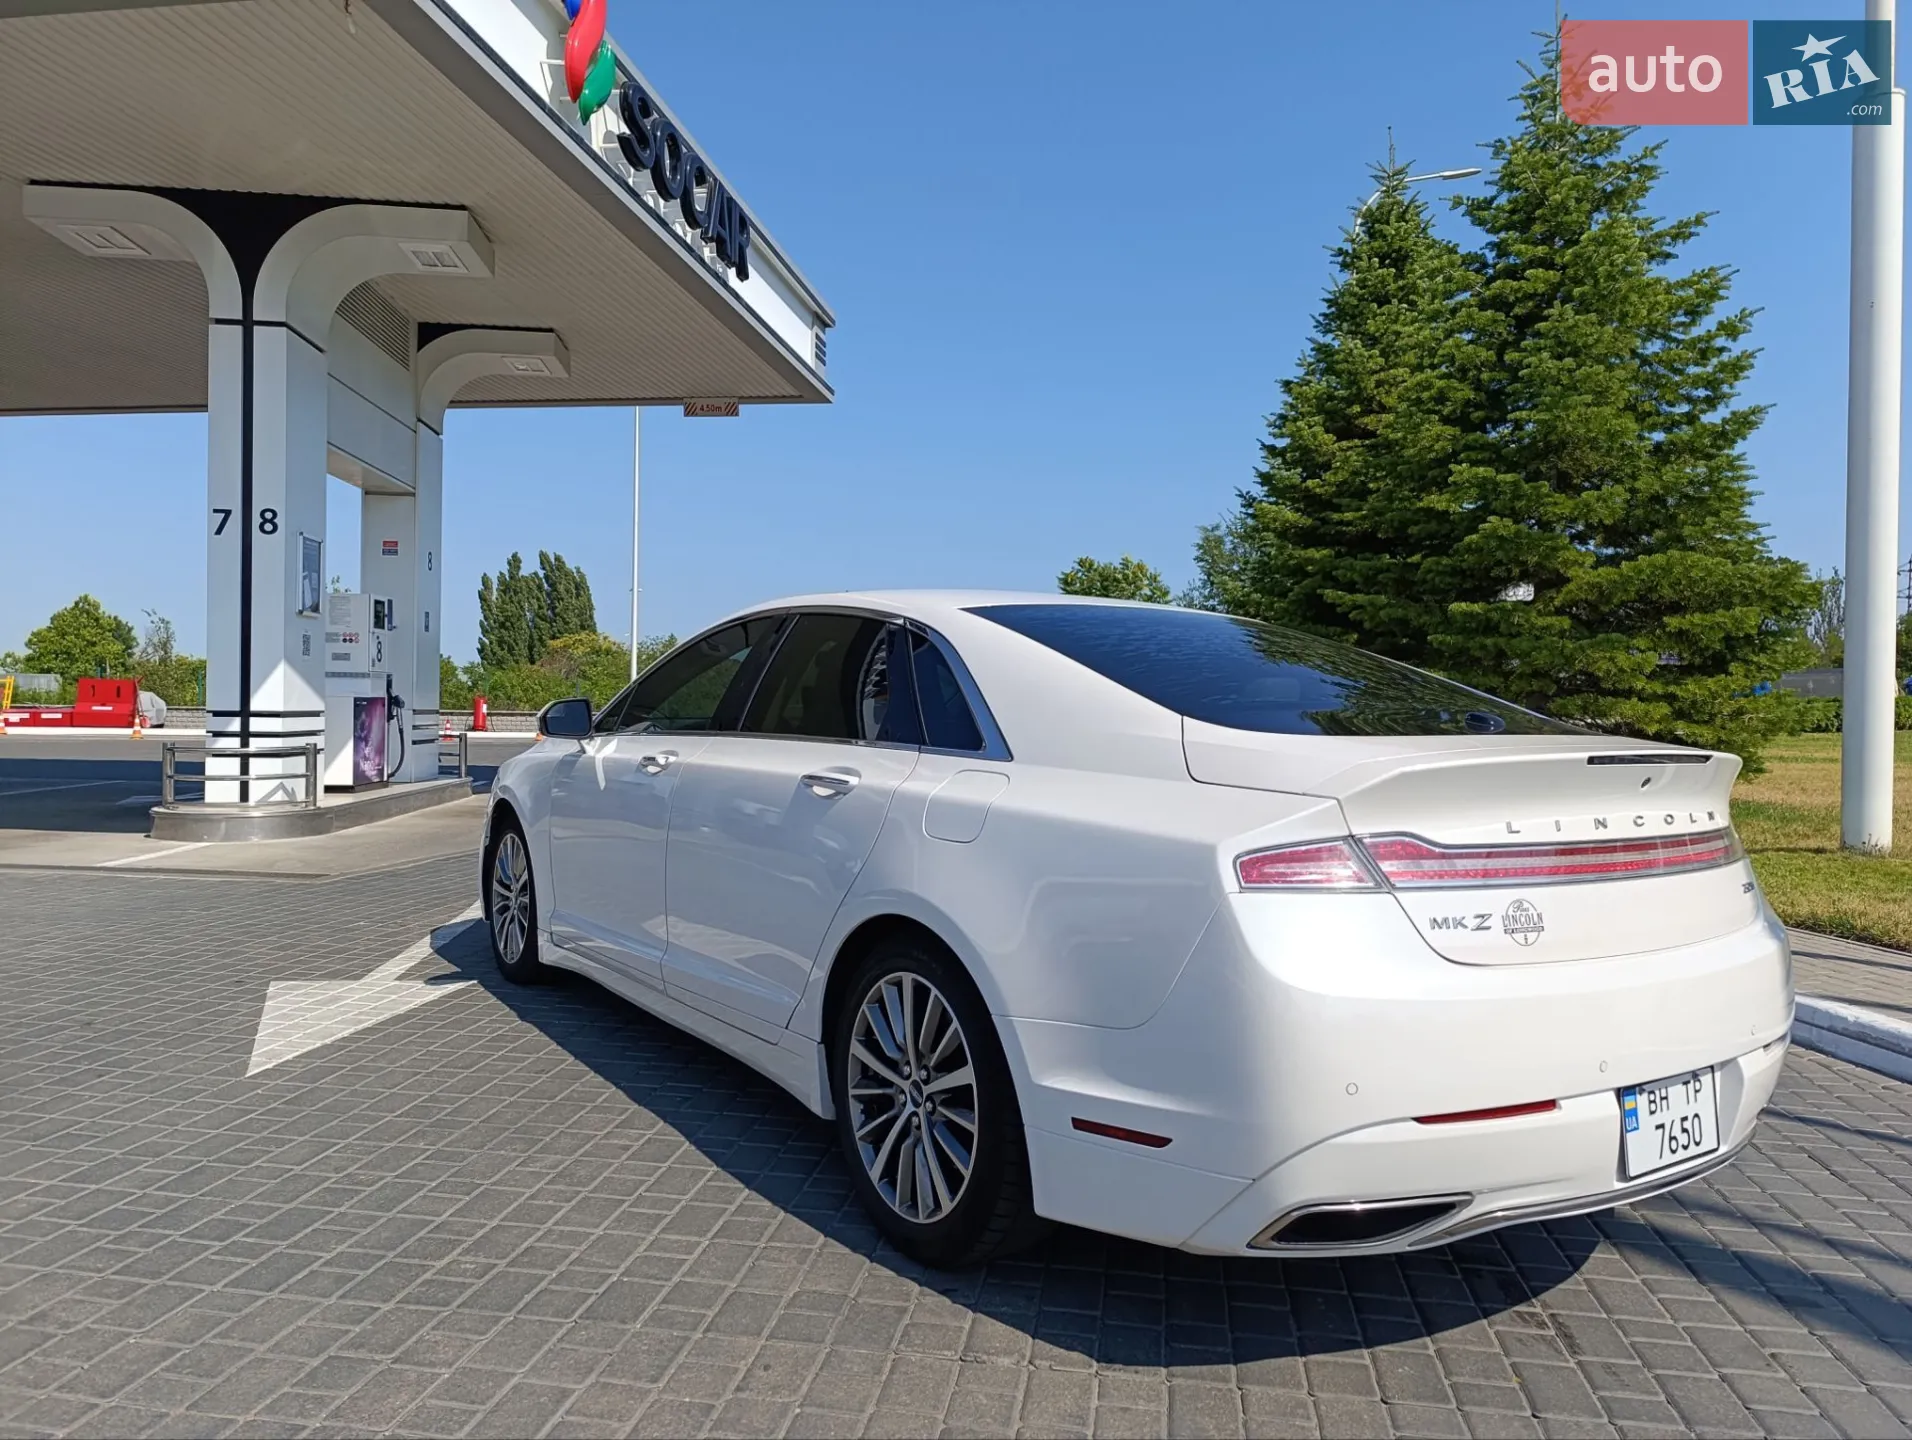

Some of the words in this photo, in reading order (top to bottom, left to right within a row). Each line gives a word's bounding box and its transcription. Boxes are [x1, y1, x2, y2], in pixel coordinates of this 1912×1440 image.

[616, 80, 750, 282] SOCAR
[212, 508, 233, 536] 7
[258, 508, 279, 535] 8
[427, 551, 433, 571] 8
[376, 640, 382, 663] 8
[1506, 810, 1716, 834] LINCOLN
[1429, 913, 1493, 931] MKZ
[1501, 911, 1544, 928] LINCOLN
[1647, 1085, 1669, 1116] BH
[1681, 1078, 1703, 1105] TP
[1625, 1115, 1638, 1131] UA
[1655, 1112, 1703, 1160] 7650
